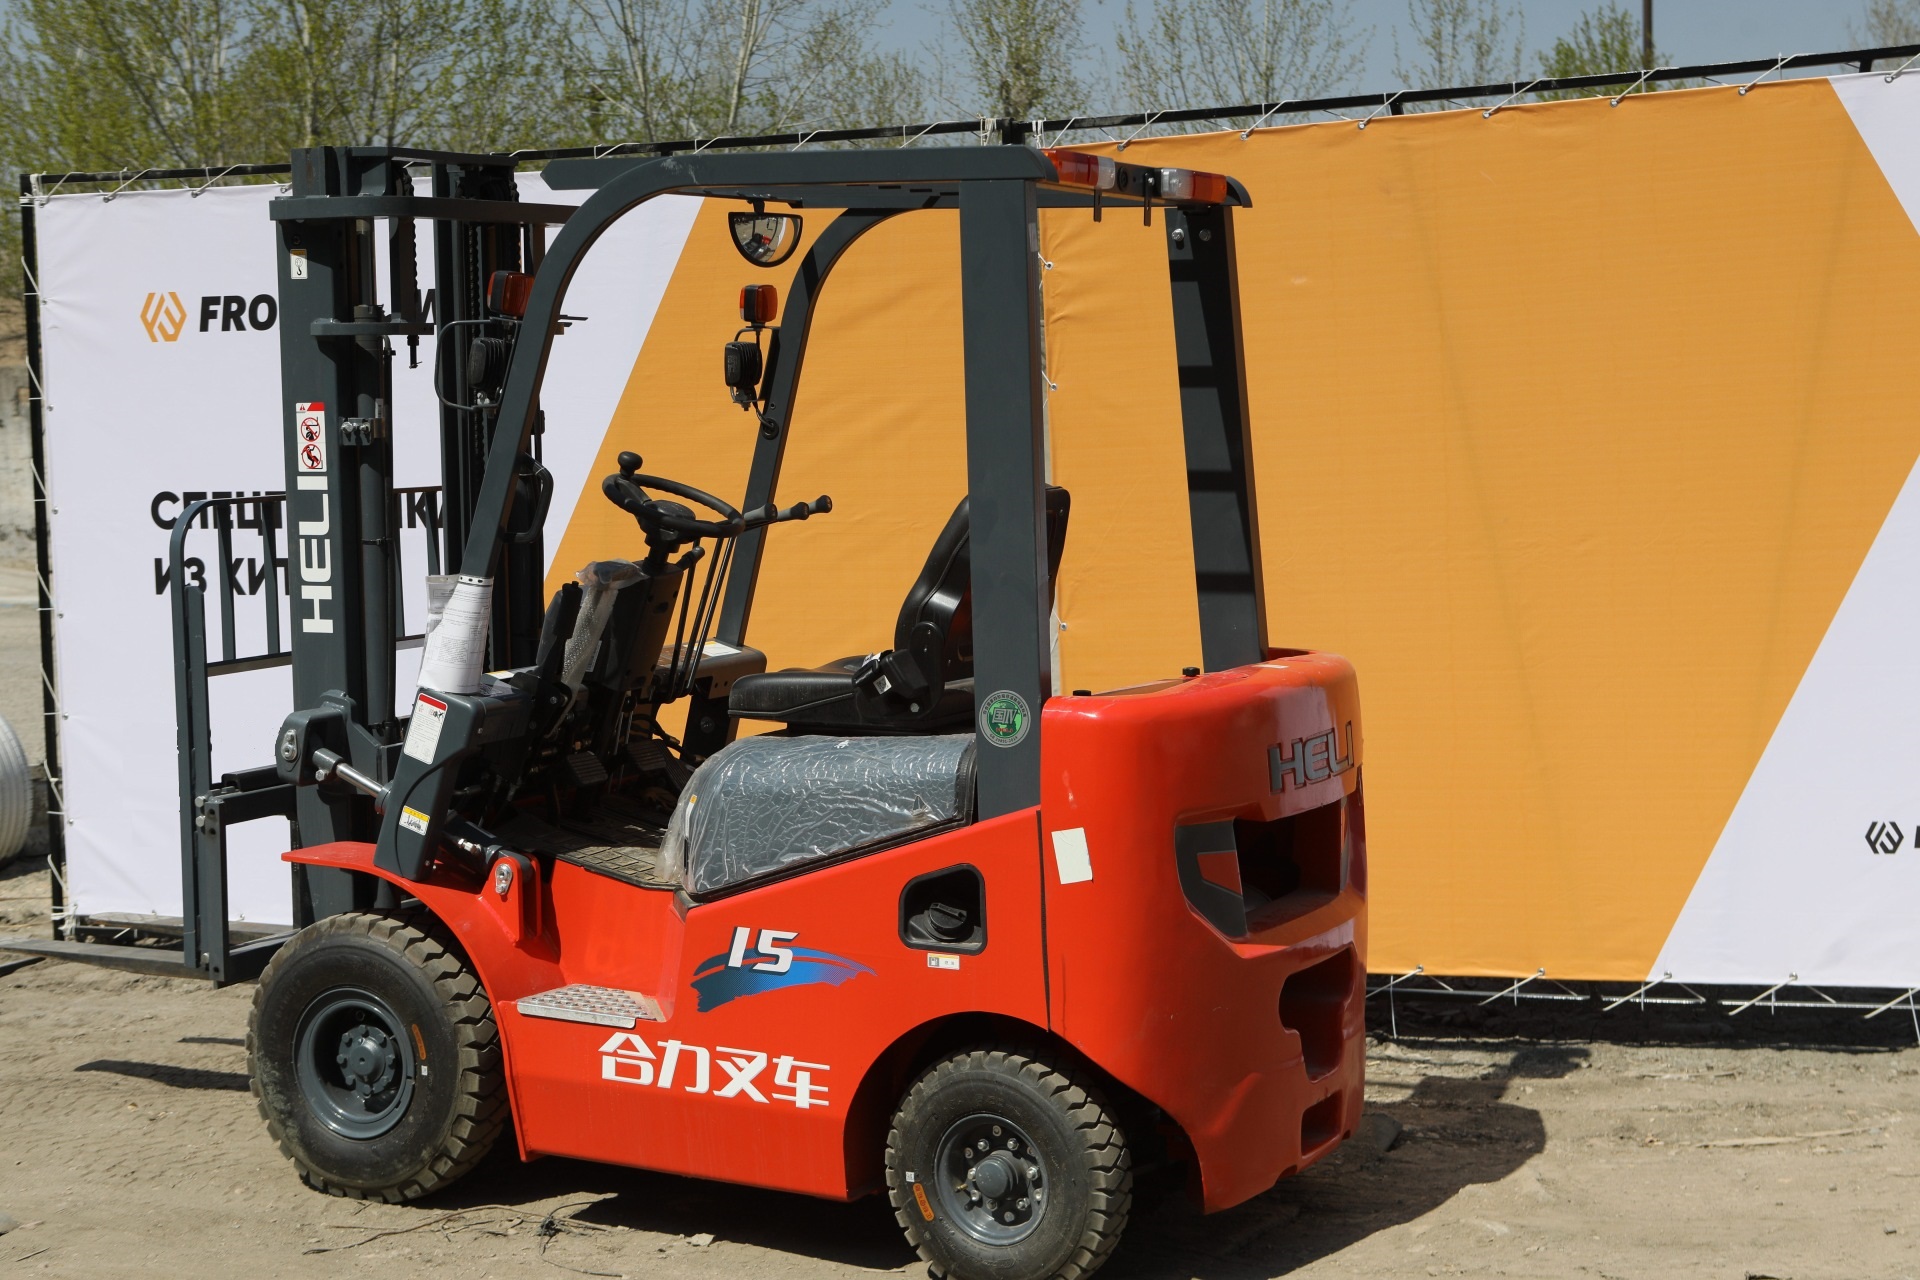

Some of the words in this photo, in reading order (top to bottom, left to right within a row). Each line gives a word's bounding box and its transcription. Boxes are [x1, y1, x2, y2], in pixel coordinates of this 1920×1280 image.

[199, 293, 278, 332] FRO
[230, 557, 290, 596] КИТ
[297, 475, 333, 633] HELI
[1268, 720, 1355, 794] HELI
[727, 926, 799, 973] 15
[598, 1031, 830, 1109] 合力叉车
